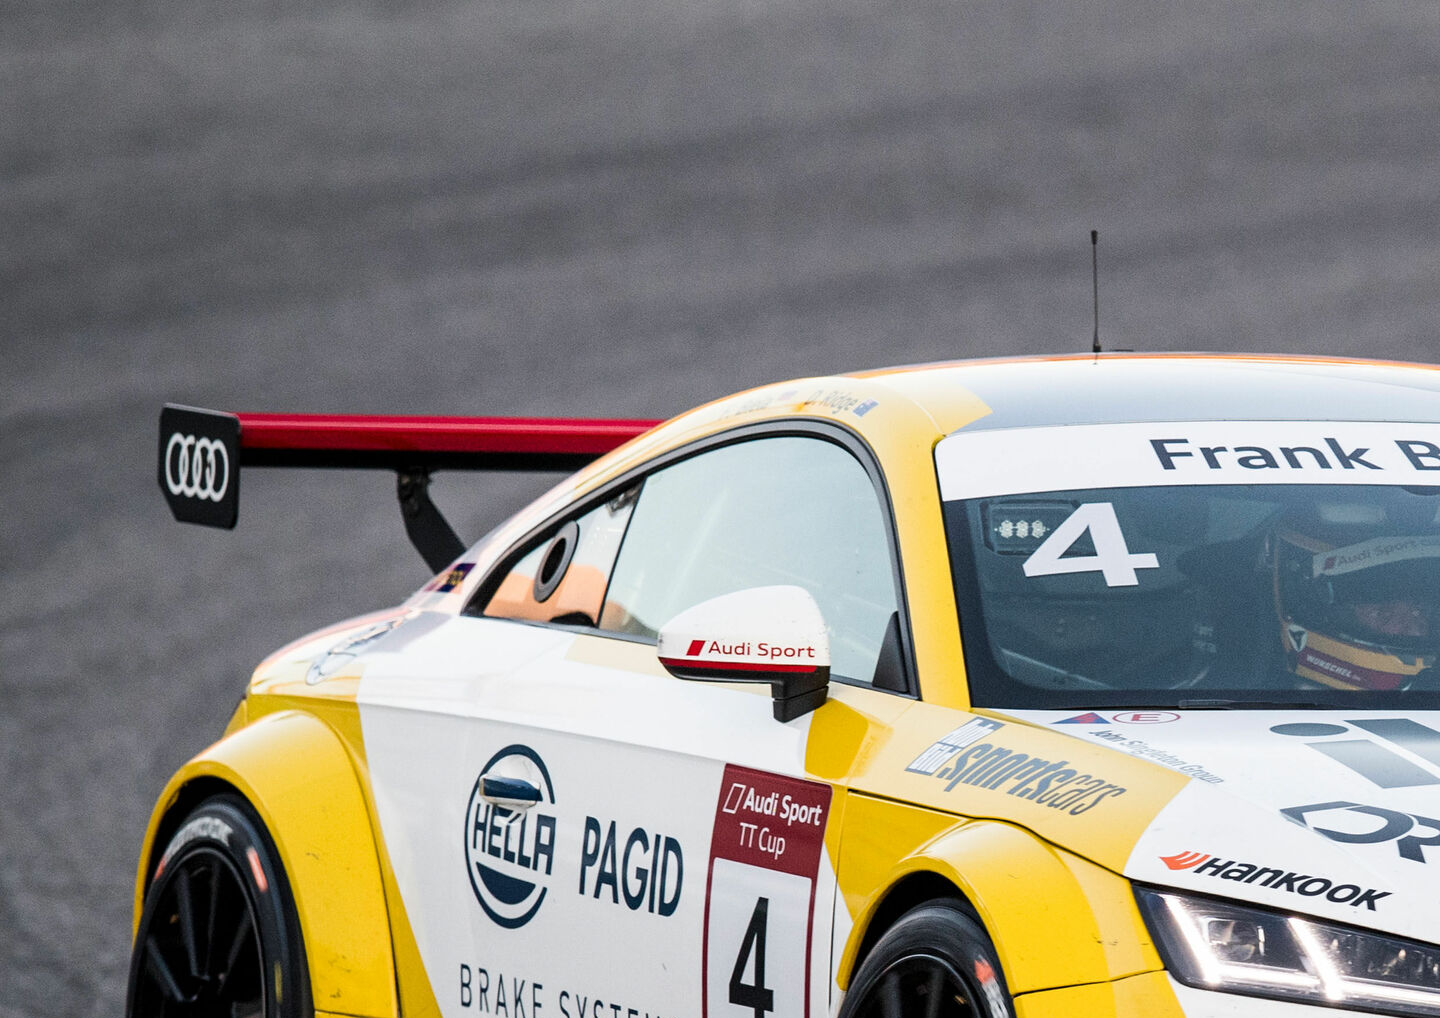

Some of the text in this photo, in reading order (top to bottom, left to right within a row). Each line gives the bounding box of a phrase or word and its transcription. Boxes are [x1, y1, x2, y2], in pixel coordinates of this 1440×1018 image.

[1149, 437, 1384, 471] Frank
[1022, 502, 1160, 587] 4
[708, 641, 815, 660] Audi Sport
[742, 787, 823, 827] Audi Sport
[473, 803, 557, 876] HELLA
[739, 822, 786, 861] TT Cup
[578, 815, 684, 918] PAGID
